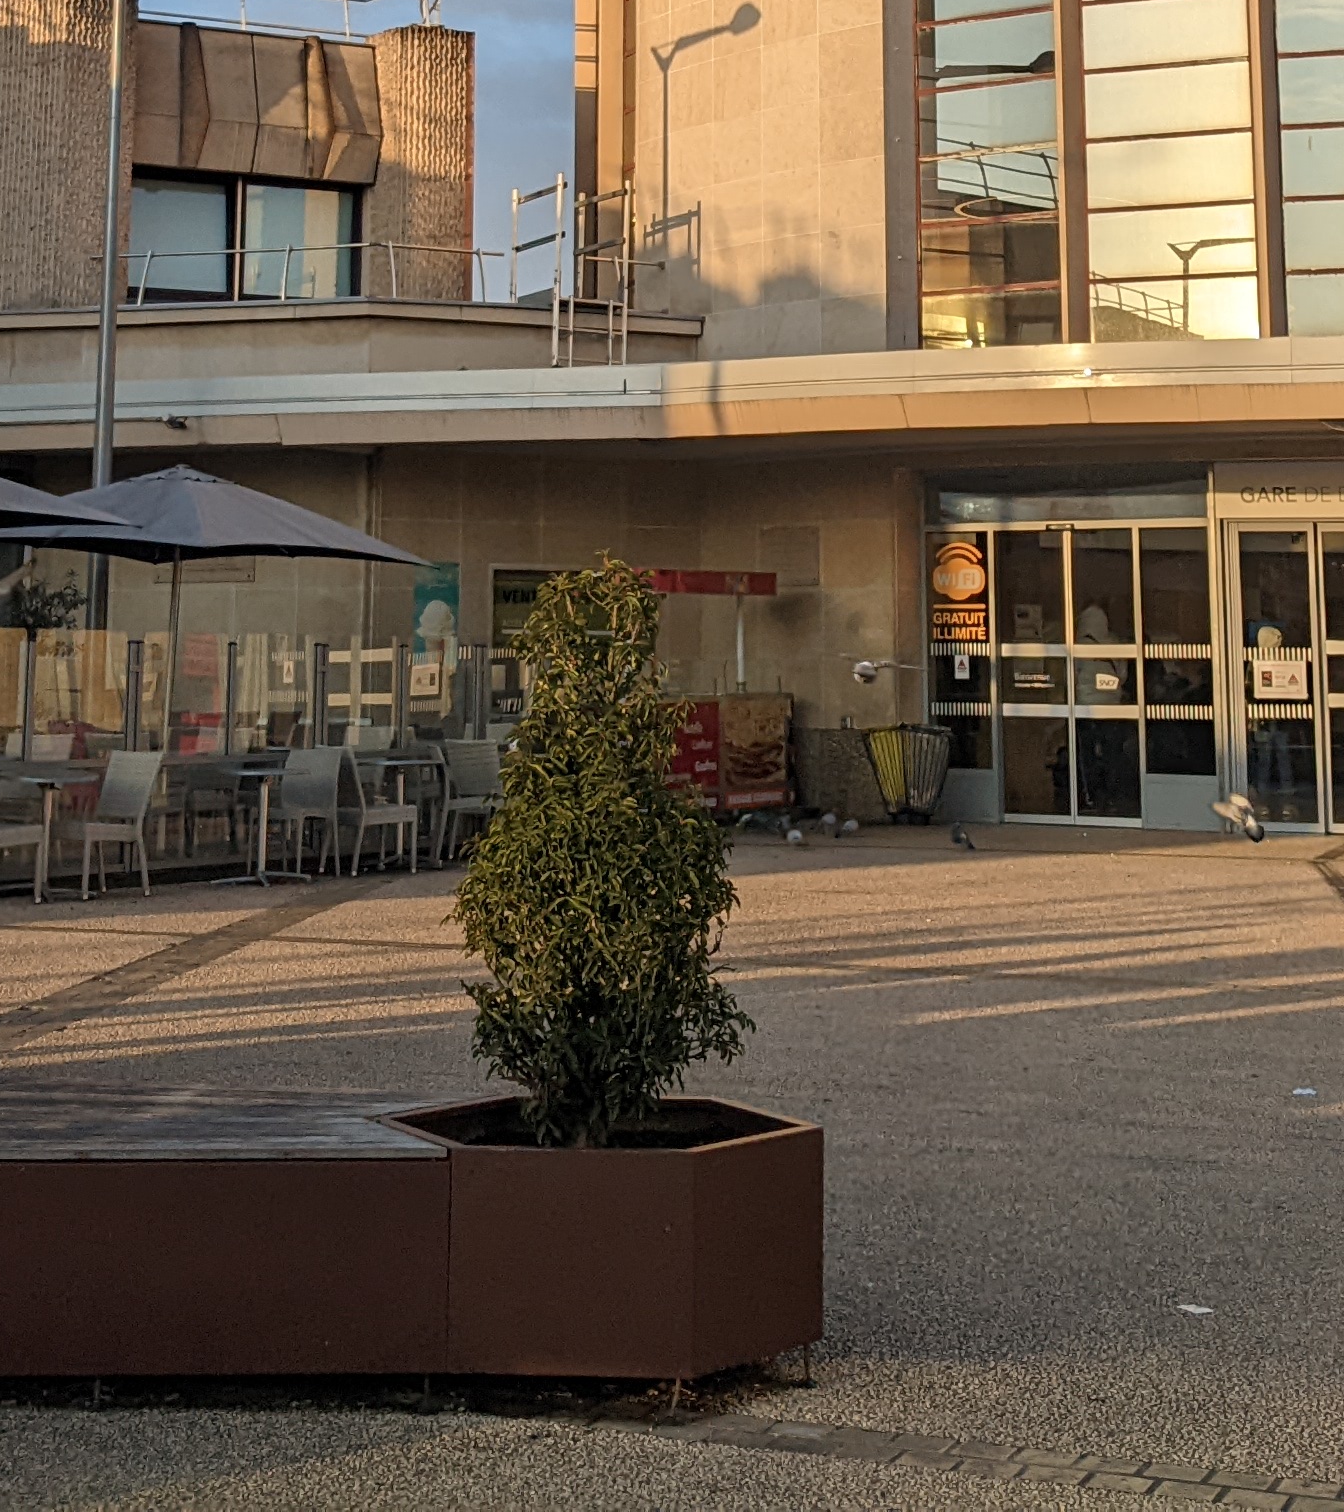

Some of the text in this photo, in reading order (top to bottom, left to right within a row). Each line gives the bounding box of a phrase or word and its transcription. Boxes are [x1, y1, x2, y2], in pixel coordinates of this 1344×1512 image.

[1240, 486, 1298, 503] GARE
[1305, 486, 1332, 503] DE
[933, 611, 987, 625] GRATUIT
[933, 623, 987, 640] ILLIMITÉ
